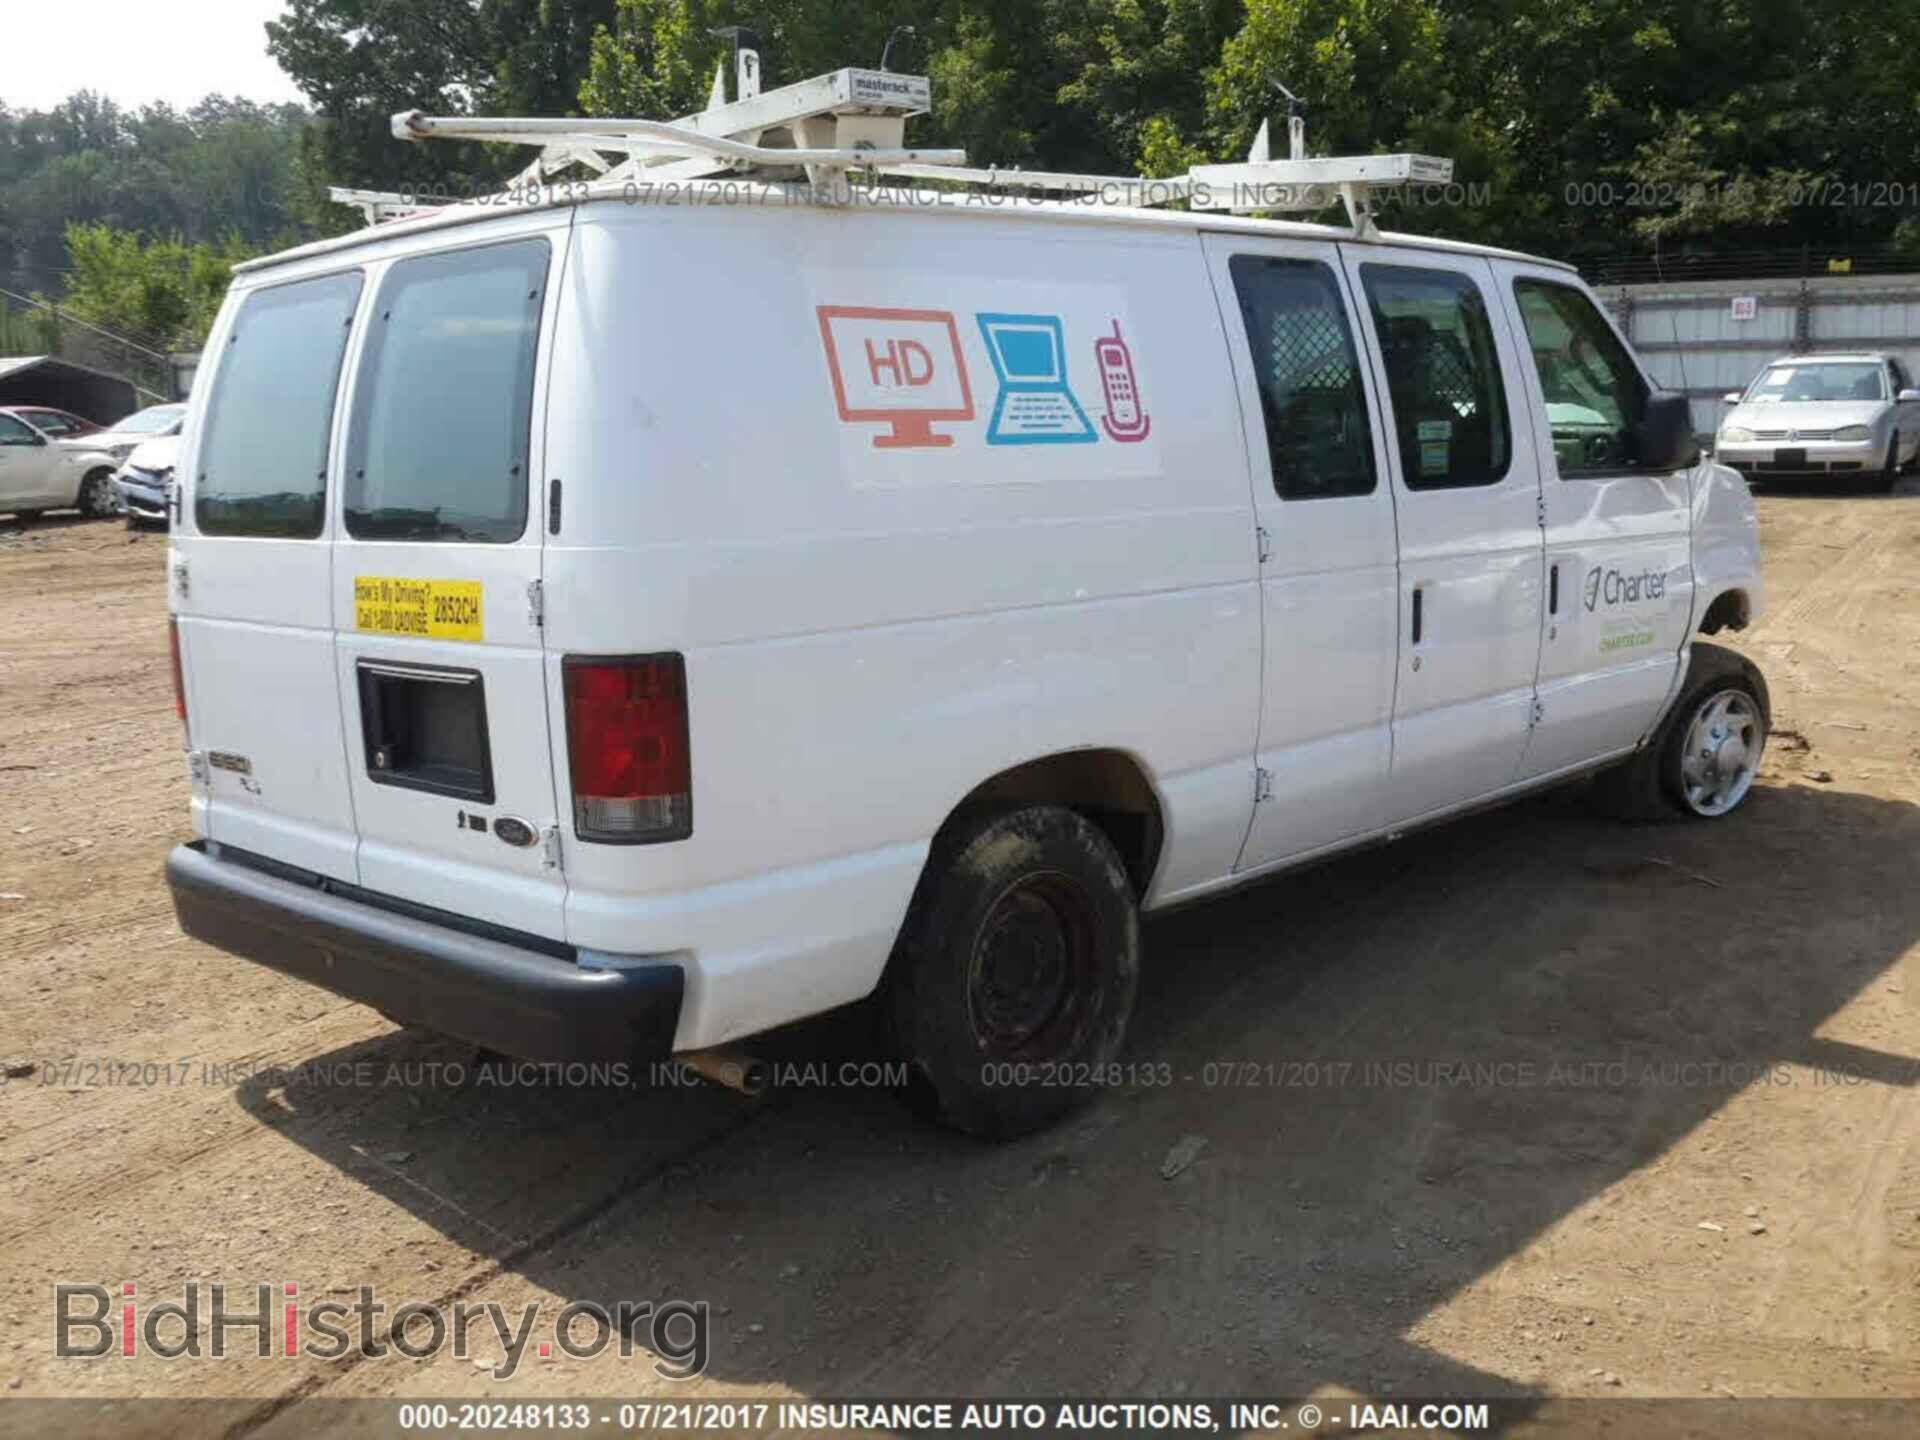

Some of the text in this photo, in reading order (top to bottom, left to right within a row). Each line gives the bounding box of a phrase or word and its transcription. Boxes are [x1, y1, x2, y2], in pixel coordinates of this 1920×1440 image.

[864, 337, 934, 387] HD
[1603, 568, 1667, 605] Charter
[434, 595, 480, 625] 2852CH
